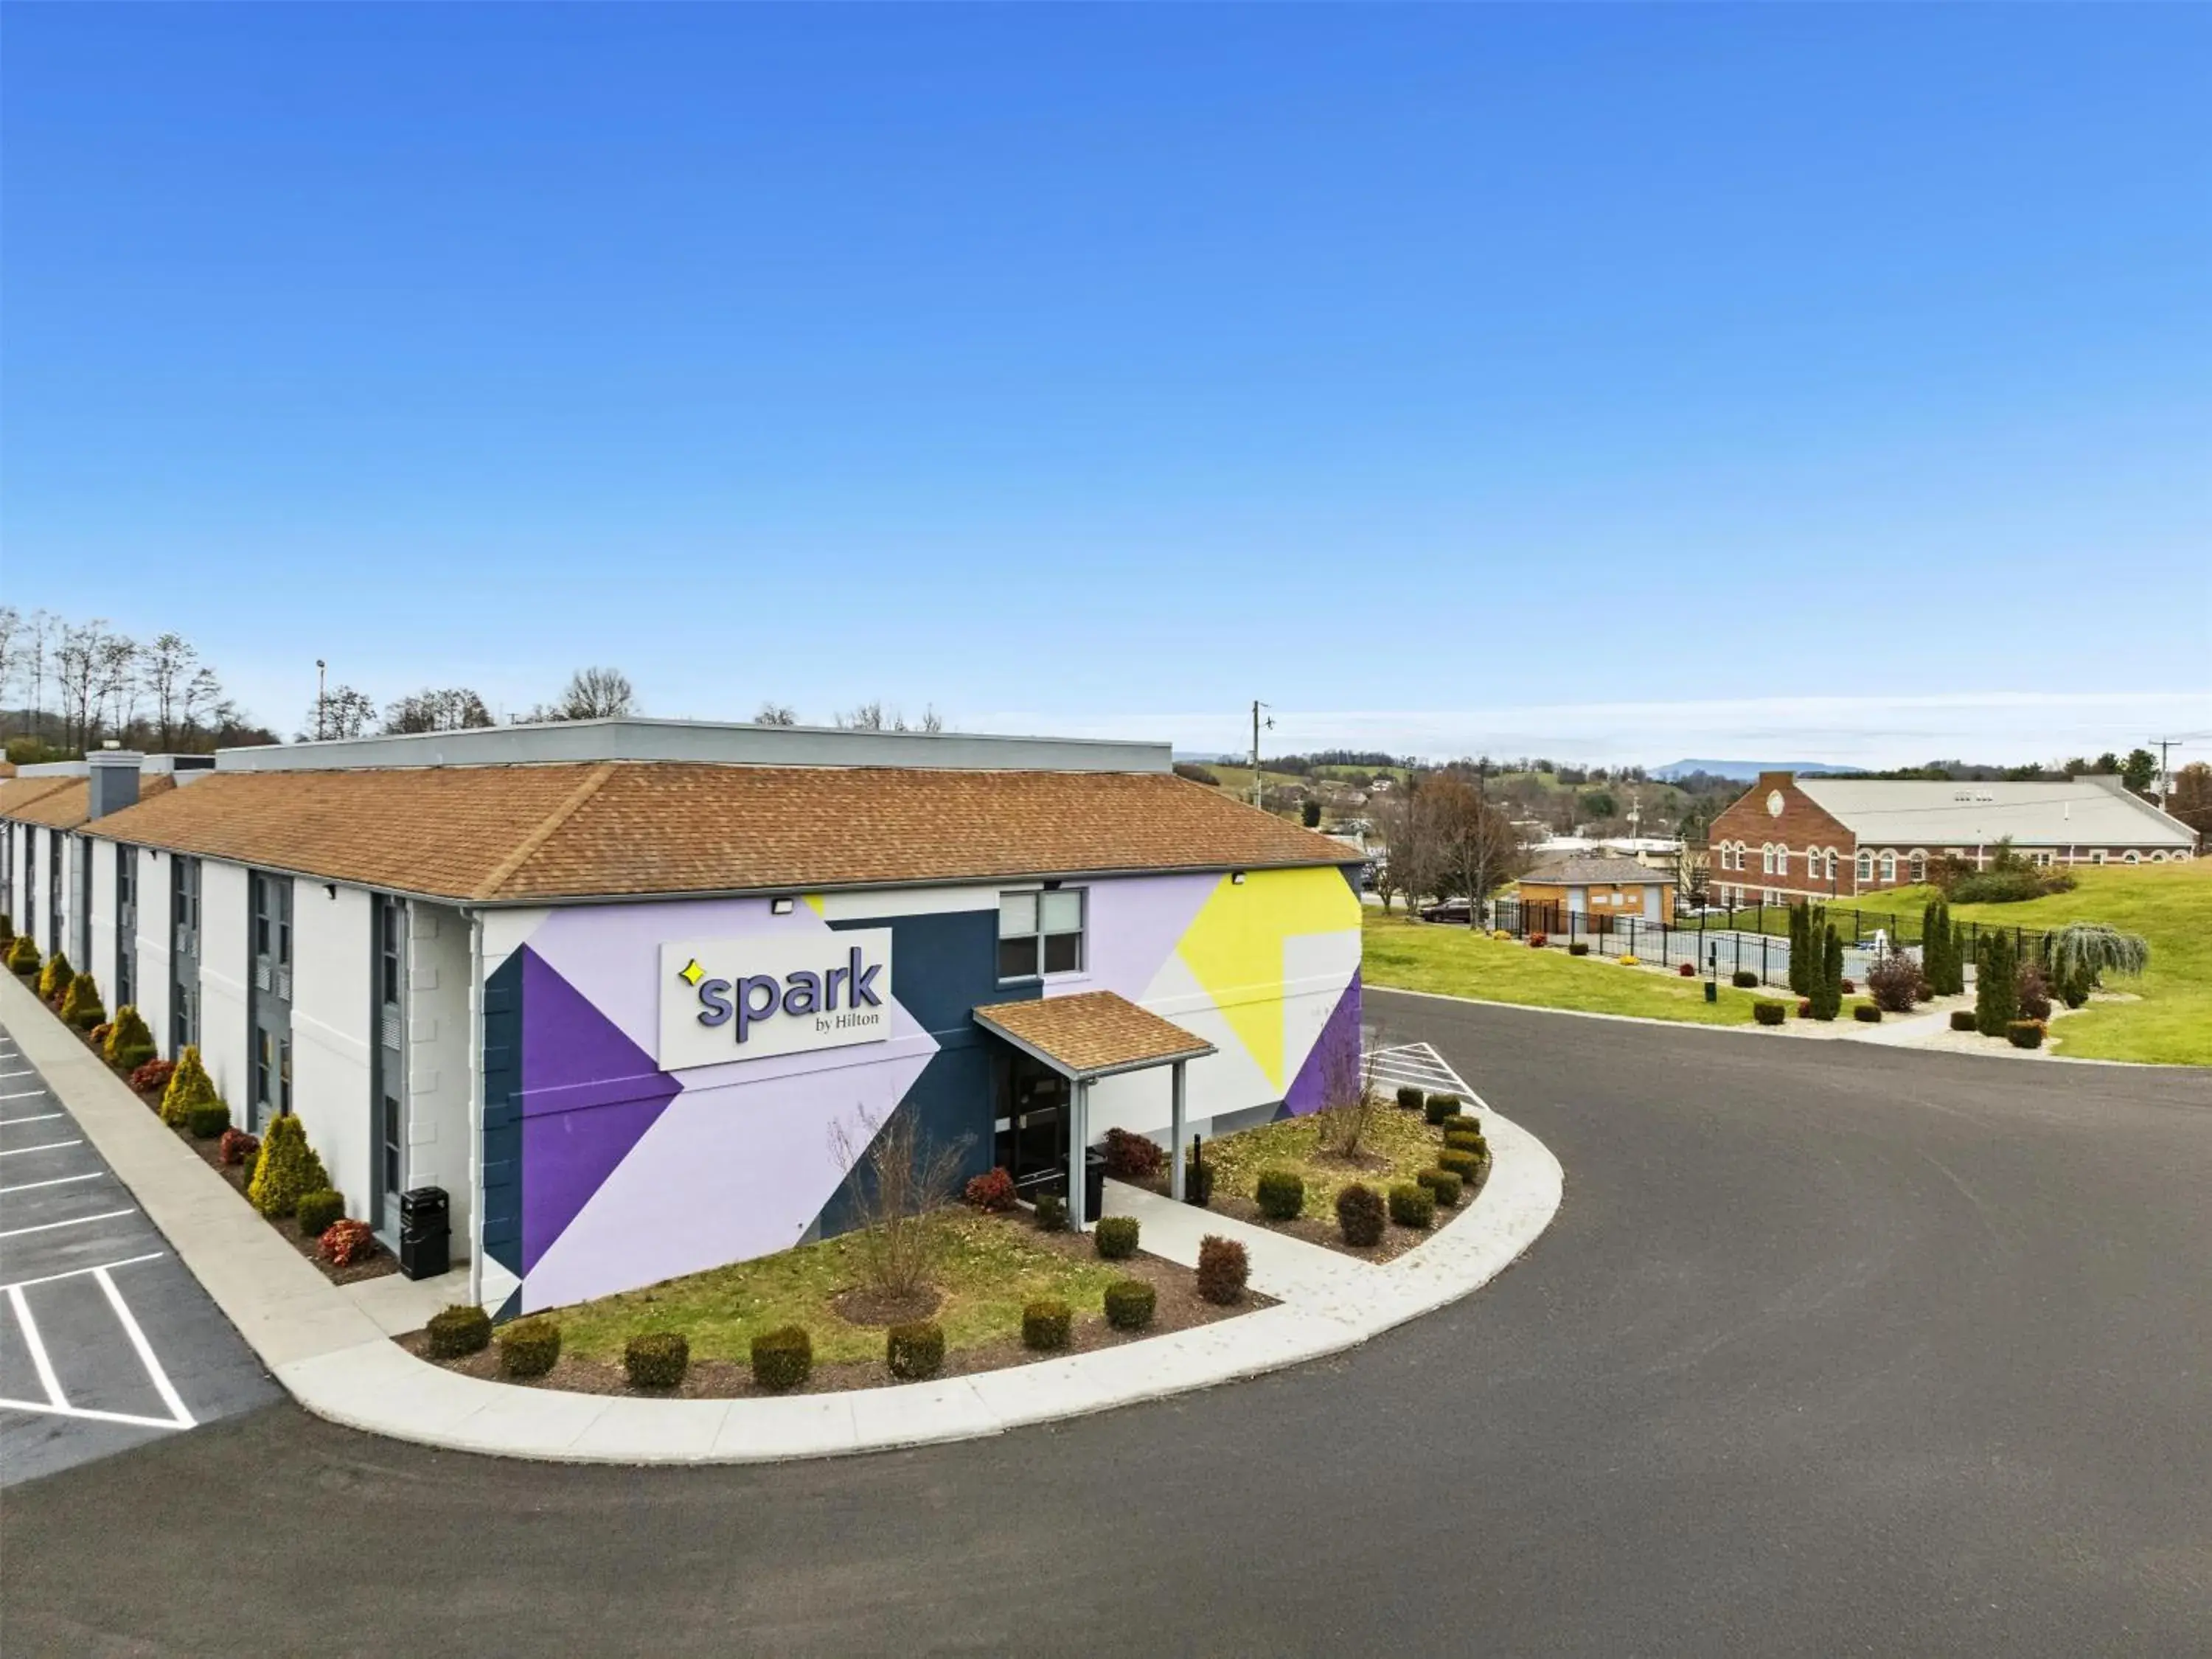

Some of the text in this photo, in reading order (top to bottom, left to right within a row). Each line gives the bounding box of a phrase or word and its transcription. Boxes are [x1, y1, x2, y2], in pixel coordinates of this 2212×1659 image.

[698, 947, 882, 1043] spark
[816, 1013, 879, 1034] by Hilton
